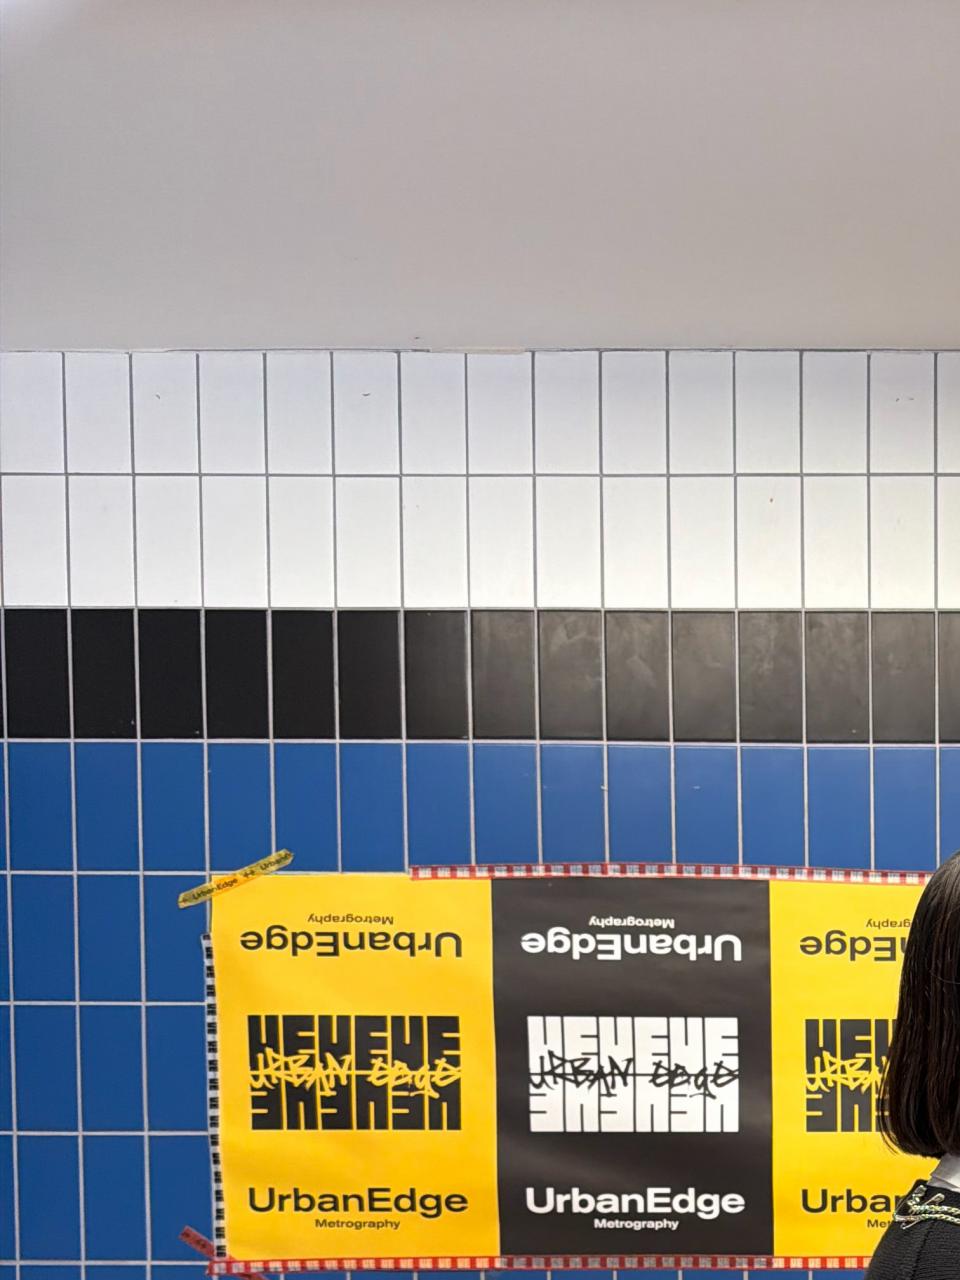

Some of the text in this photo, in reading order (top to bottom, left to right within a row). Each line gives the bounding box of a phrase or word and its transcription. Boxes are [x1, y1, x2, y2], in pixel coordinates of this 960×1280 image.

[308, 913, 394, 925] Metrography
[588, 916, 675, 929] Metrography
[866, 918, 912, 929] graphy
[240, 925, 463, 957] UrbanEdge
[520, 926, 742, 961] UrbanEdge
[248, 1187, 469, 1219] UrbanEdge
[525, 1187, 745, 1220] UrbanEdge
[315, 1219, 401, 1230] Metrography
[594, 1218, 679, 1231] Metrography
